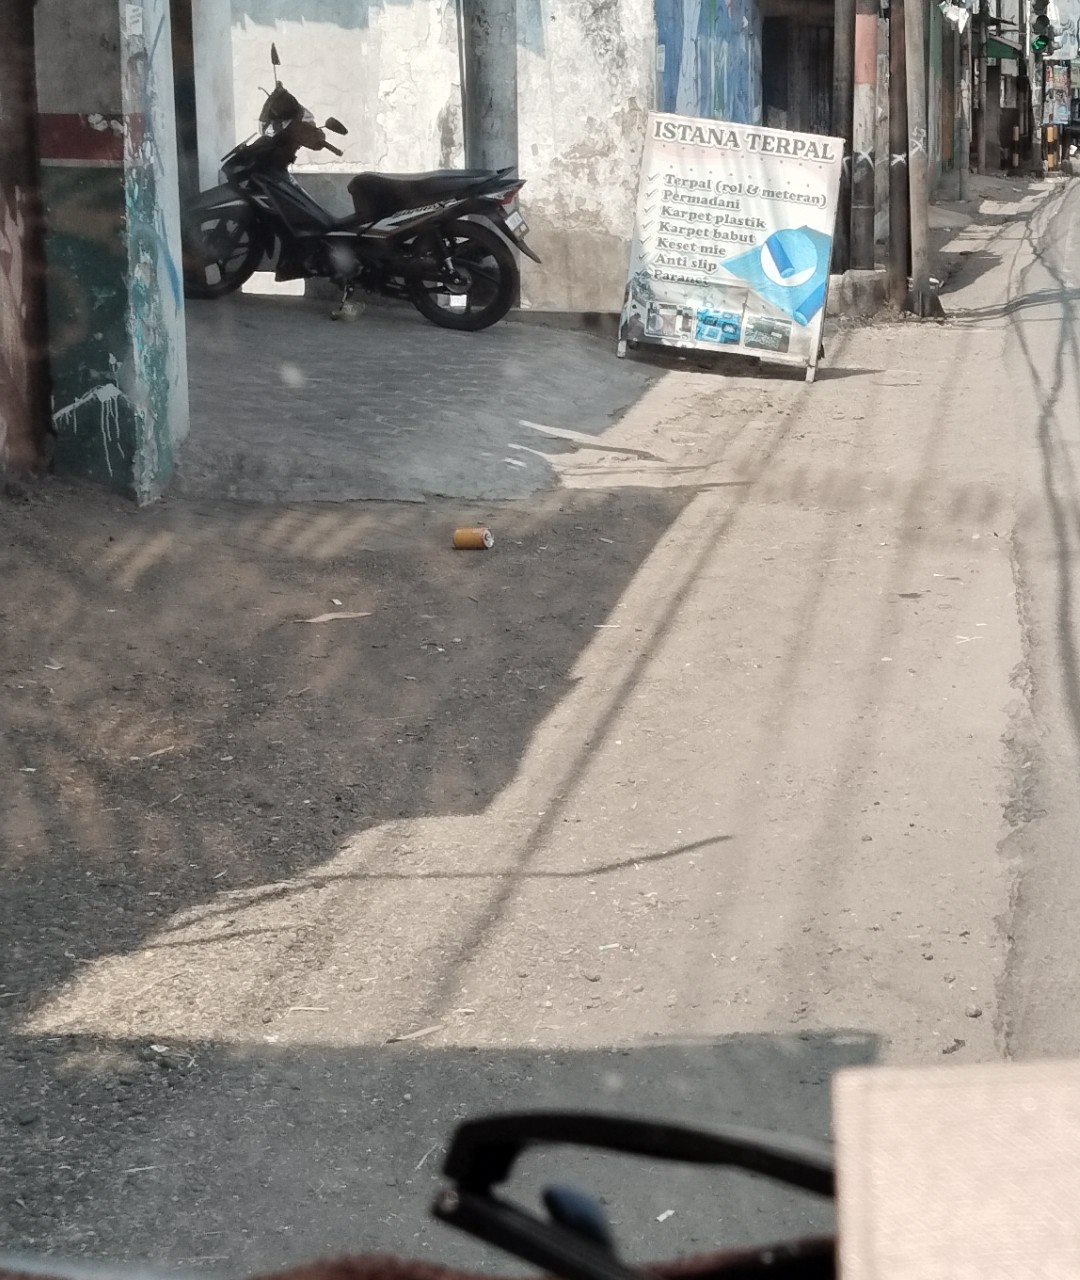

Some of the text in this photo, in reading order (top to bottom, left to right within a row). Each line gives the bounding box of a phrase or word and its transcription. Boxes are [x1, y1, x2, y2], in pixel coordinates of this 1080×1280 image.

[654, 121, 835, 161] ISTANA TERPAL
[663, 174, 827, 208] Terpal (rol & meteran)
[663, 189, 740, 210] Permadani
[661, 205, 767, 229] Karpet plastik
[659, 221, 756, 243] Karpet babut
[657, 237, 727, 255] Keset mie
[655, 253, 718, 272] Anti slip
